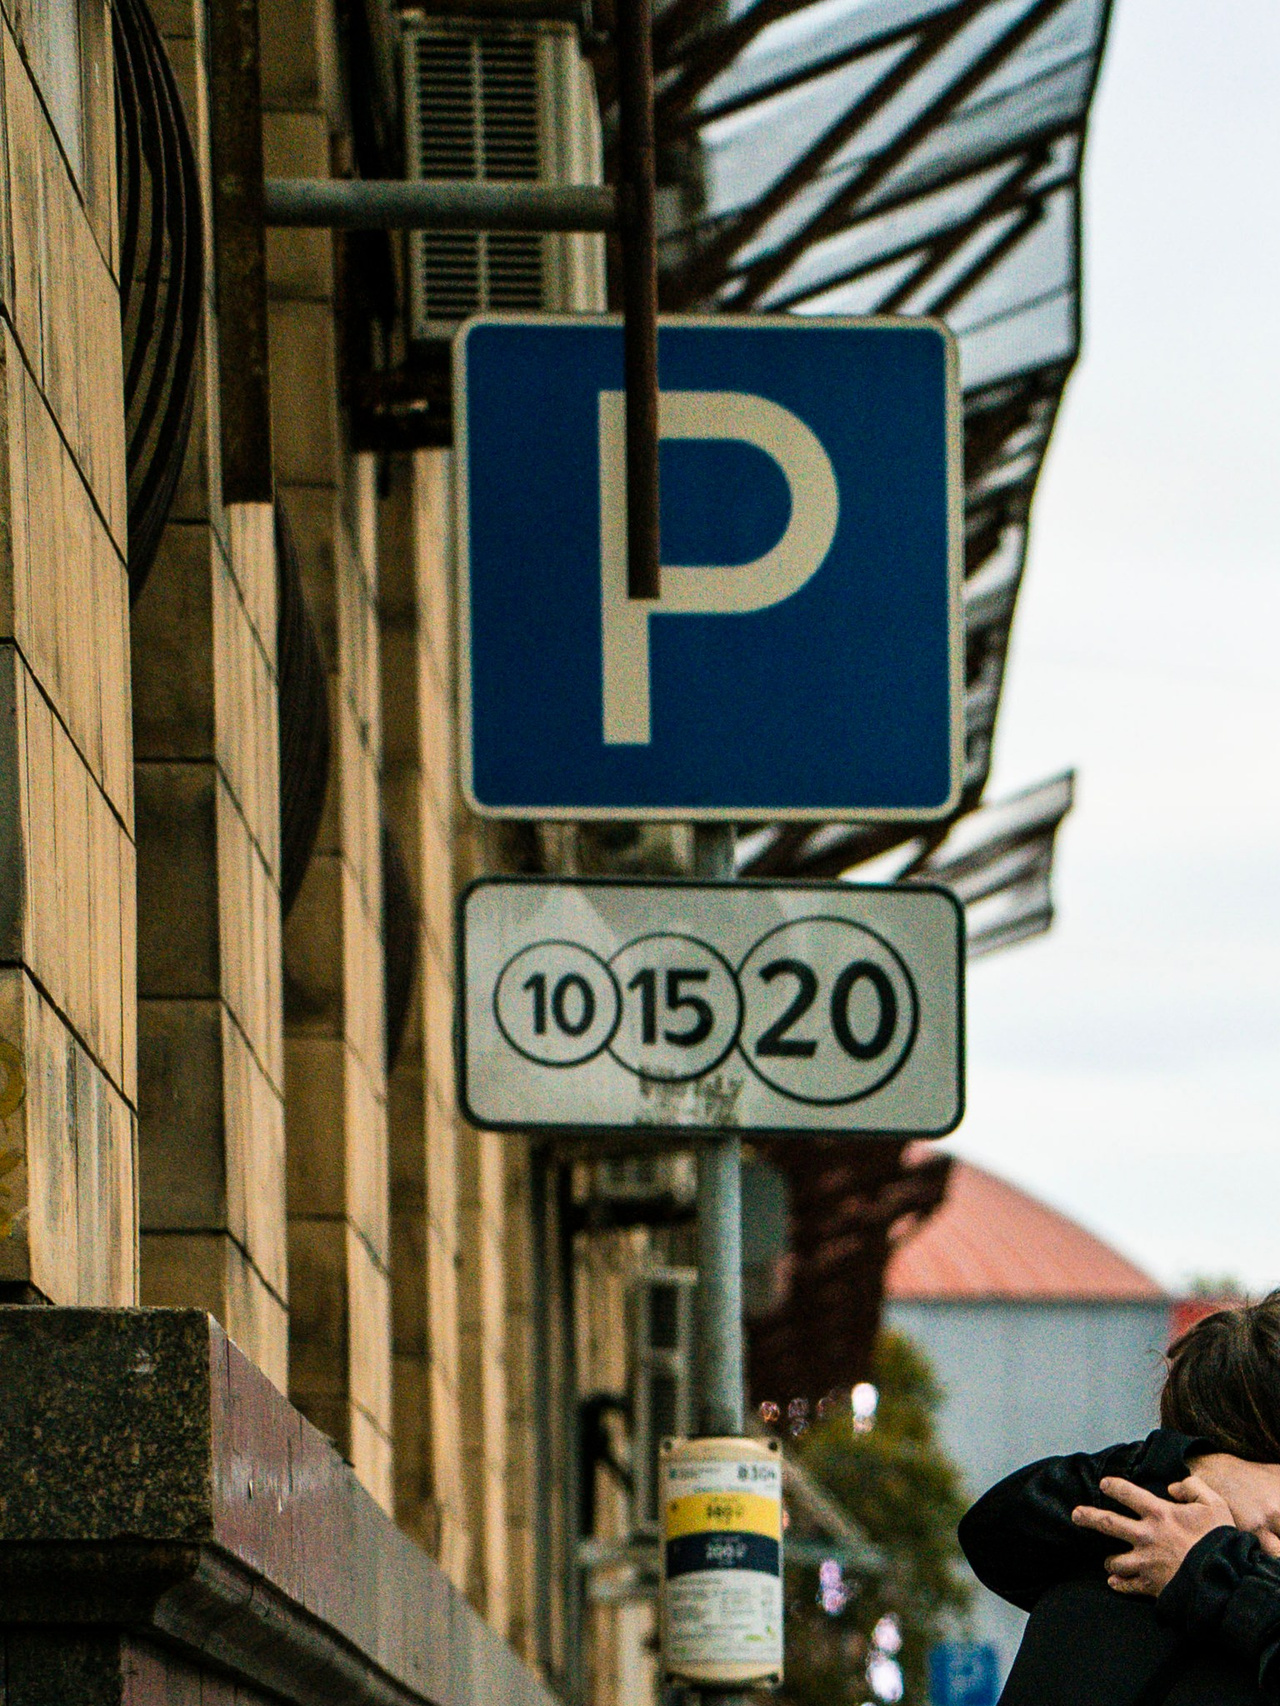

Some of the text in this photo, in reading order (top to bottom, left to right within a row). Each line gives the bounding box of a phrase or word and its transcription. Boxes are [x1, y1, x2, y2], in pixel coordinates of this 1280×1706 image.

[598, 390, 840, 745] P
[522, 958, 899, 1062] 10 15 20
